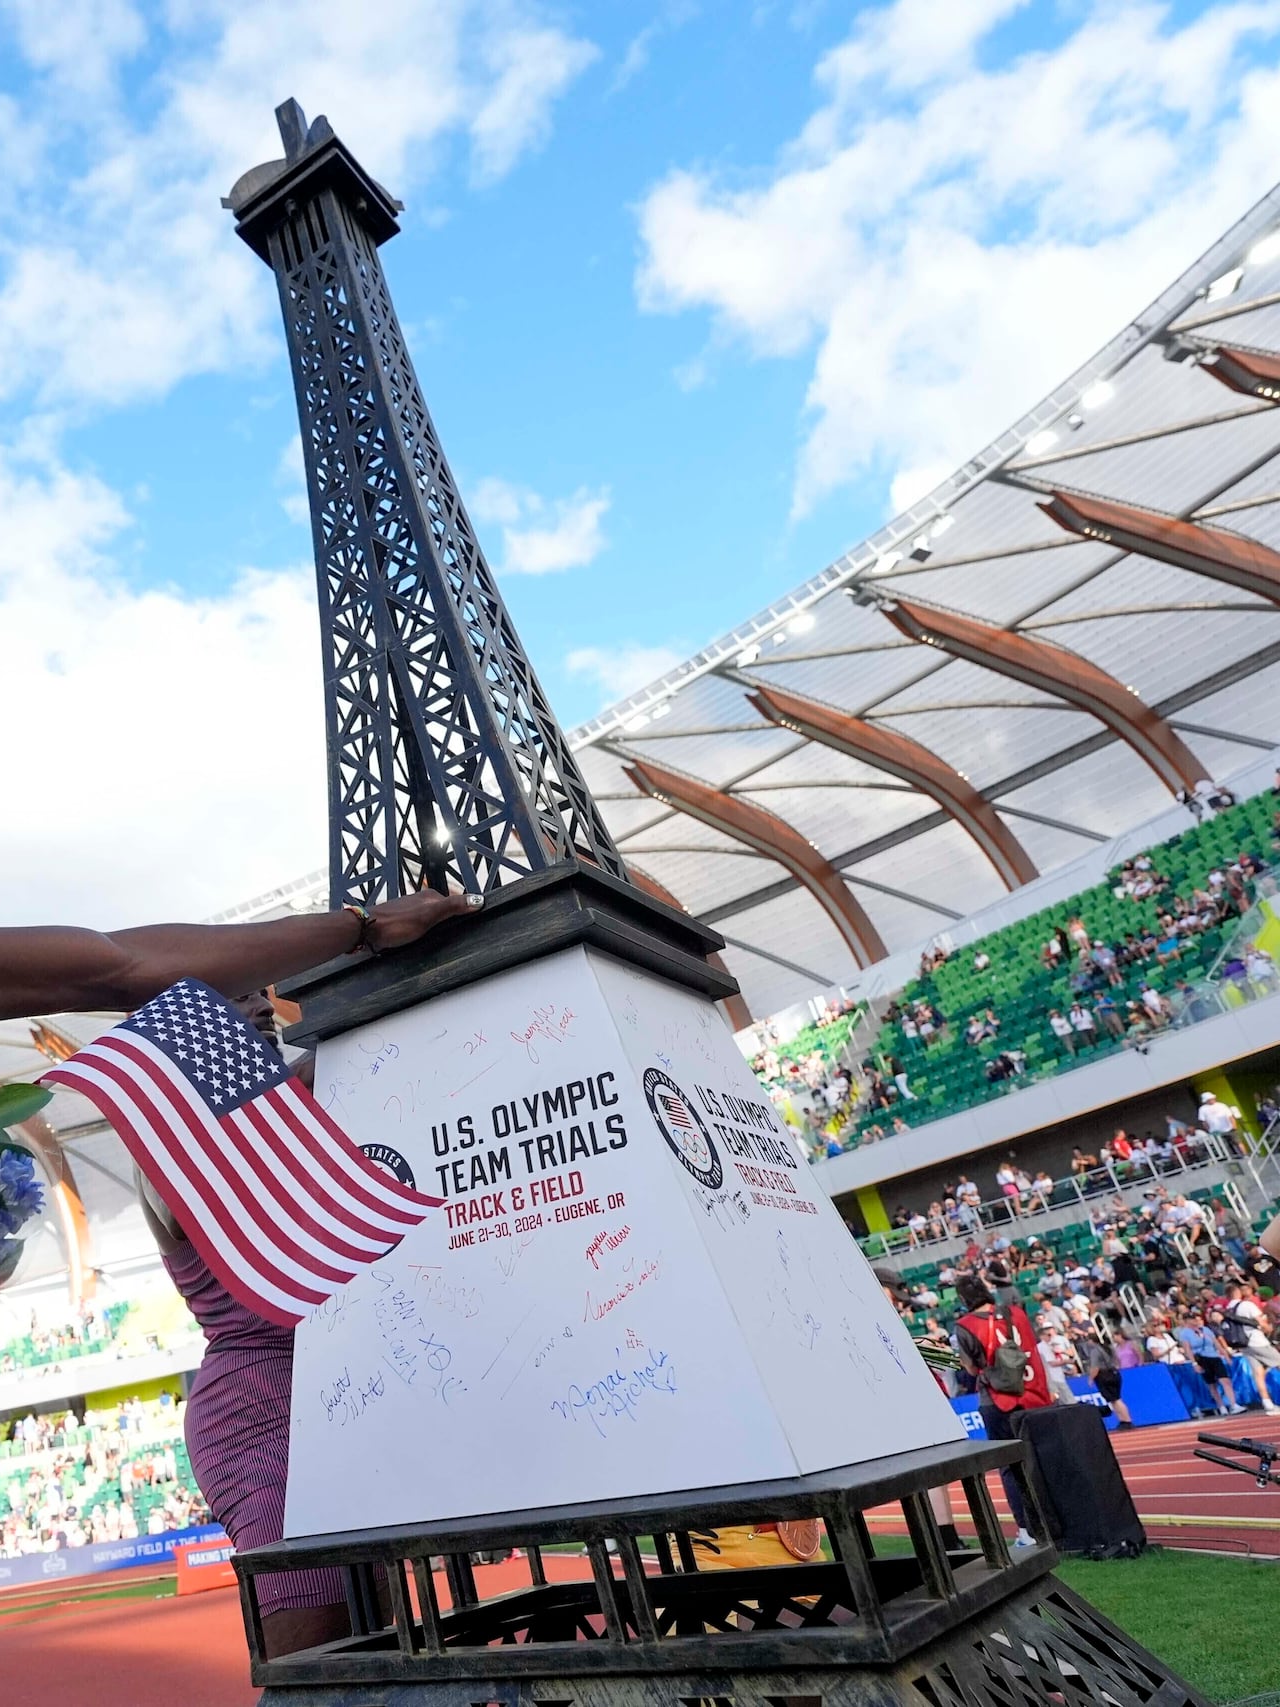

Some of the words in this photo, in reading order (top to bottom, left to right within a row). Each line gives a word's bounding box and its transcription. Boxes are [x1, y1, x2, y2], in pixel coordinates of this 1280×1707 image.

[431, 1115, 484, 1157] U.S.
[491, 1071, 619, 1139] OLYMPIC
[721, 1093, 779, 1133] OLYMPIC
[363, 1147, 402, 1168] STATES
[435, 1146, 512, 1198] TEAM
[518, 1113, 628, 1174] TRIALS
[712, 1123, 758, 1160] TEAM
[748, 1132, 798, 1169] TRIALS
[444, 1191, 507, 1229] TRACK
[511, 1187, 525, 1212] &
[529, 1171, 584, 1207] FIELD
[448, 1230, 476, 1251] JUNE
[514, 1213, 543, 1234] 2024
[554, 1199, 605, 1224] EUGENE,
[607, 1192, 626, 1210] OR
[92, 1546, 135, 1564] HAYWARD
[137, 1542, 163, 1557] FIELD
